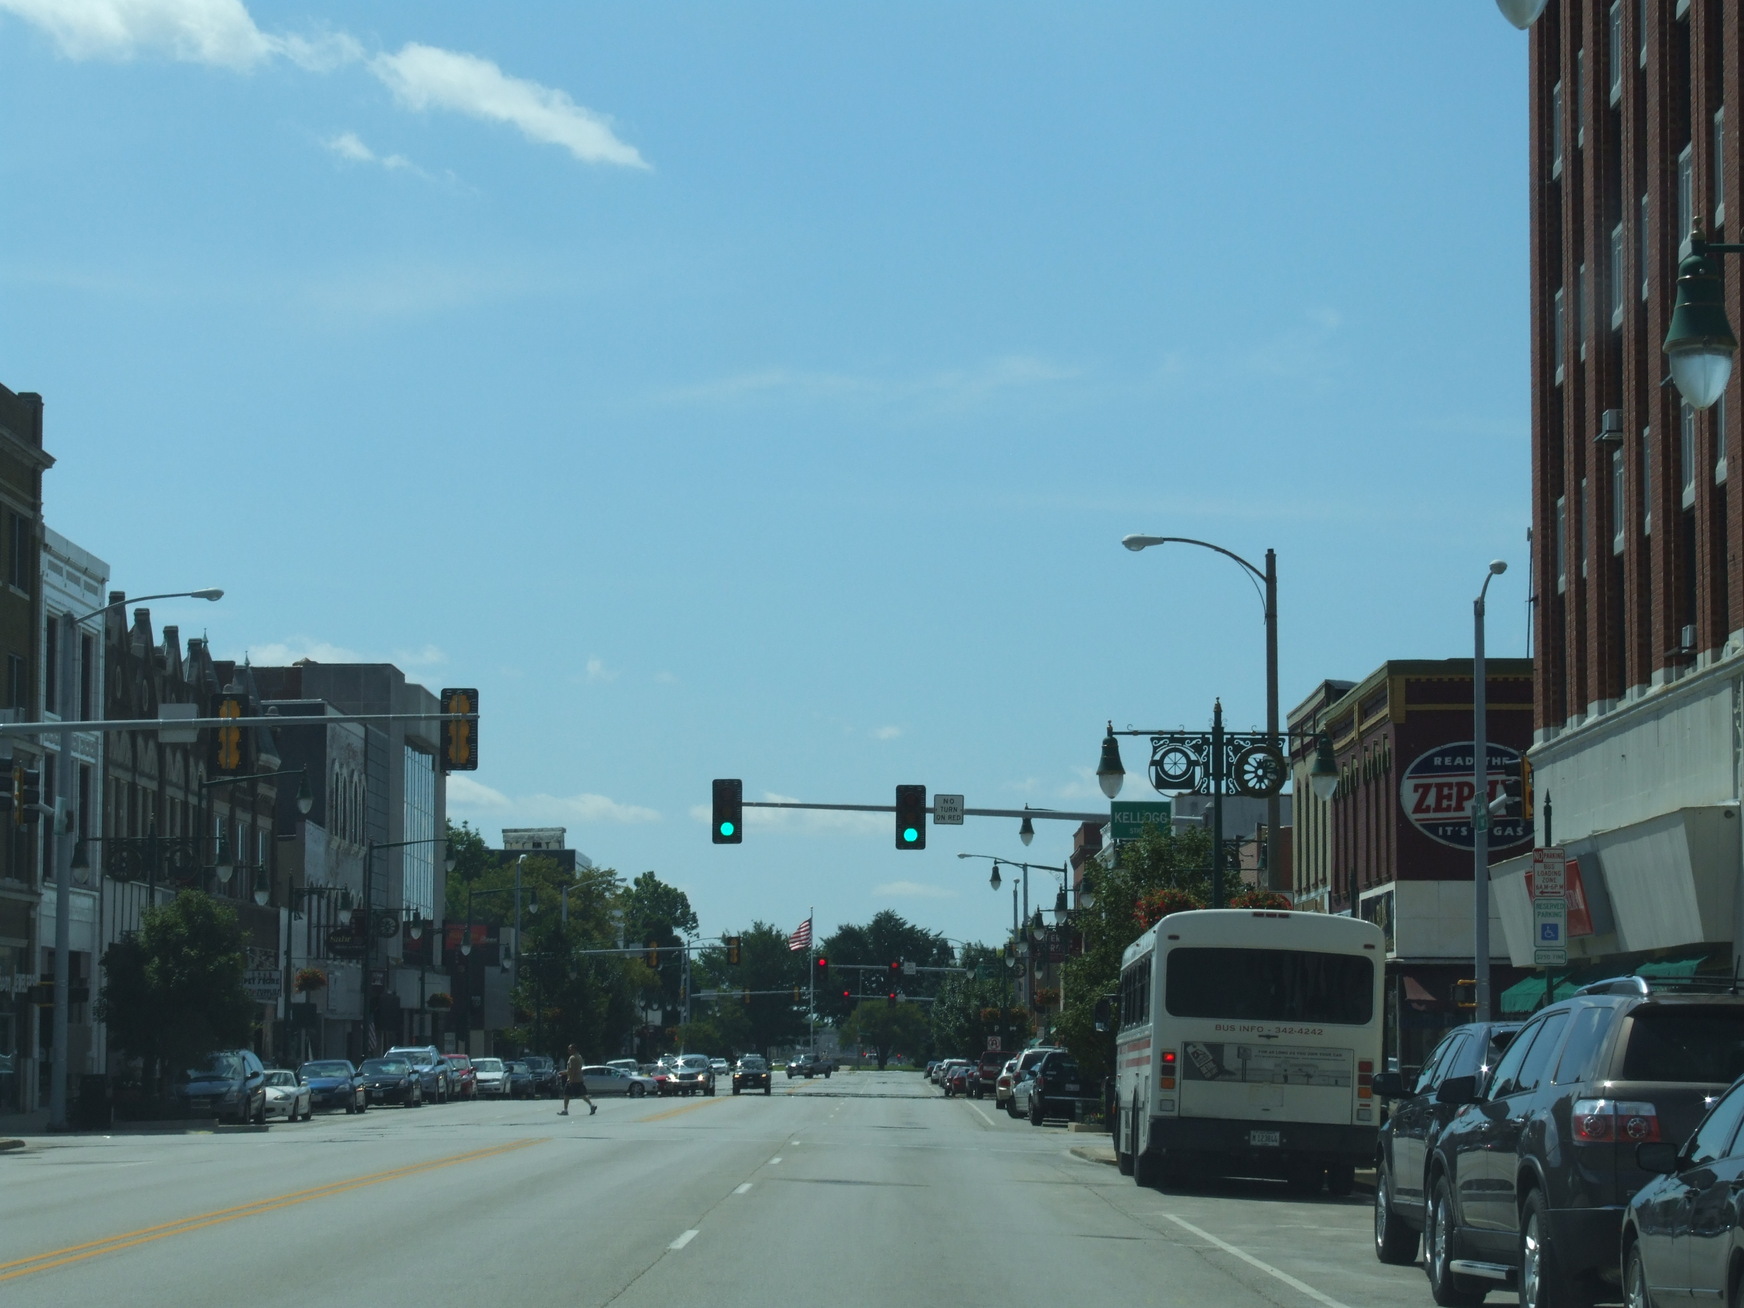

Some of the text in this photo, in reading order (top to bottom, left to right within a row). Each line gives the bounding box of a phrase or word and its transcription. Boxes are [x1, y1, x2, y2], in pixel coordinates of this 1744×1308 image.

[1433, 756, 1475, 766] READ
[1114, 811, 1168, 824] KELLOGG
[1438, 826, 1525, 836] IT'S GAS
[1534, 851, 1564, 861] NO PARKING
[1215, 1024, 1236, 1032] BUS
[1239, 1025, 1265, 1033] INFO
[1275, 1026, 1325, 1036] 342-4242
